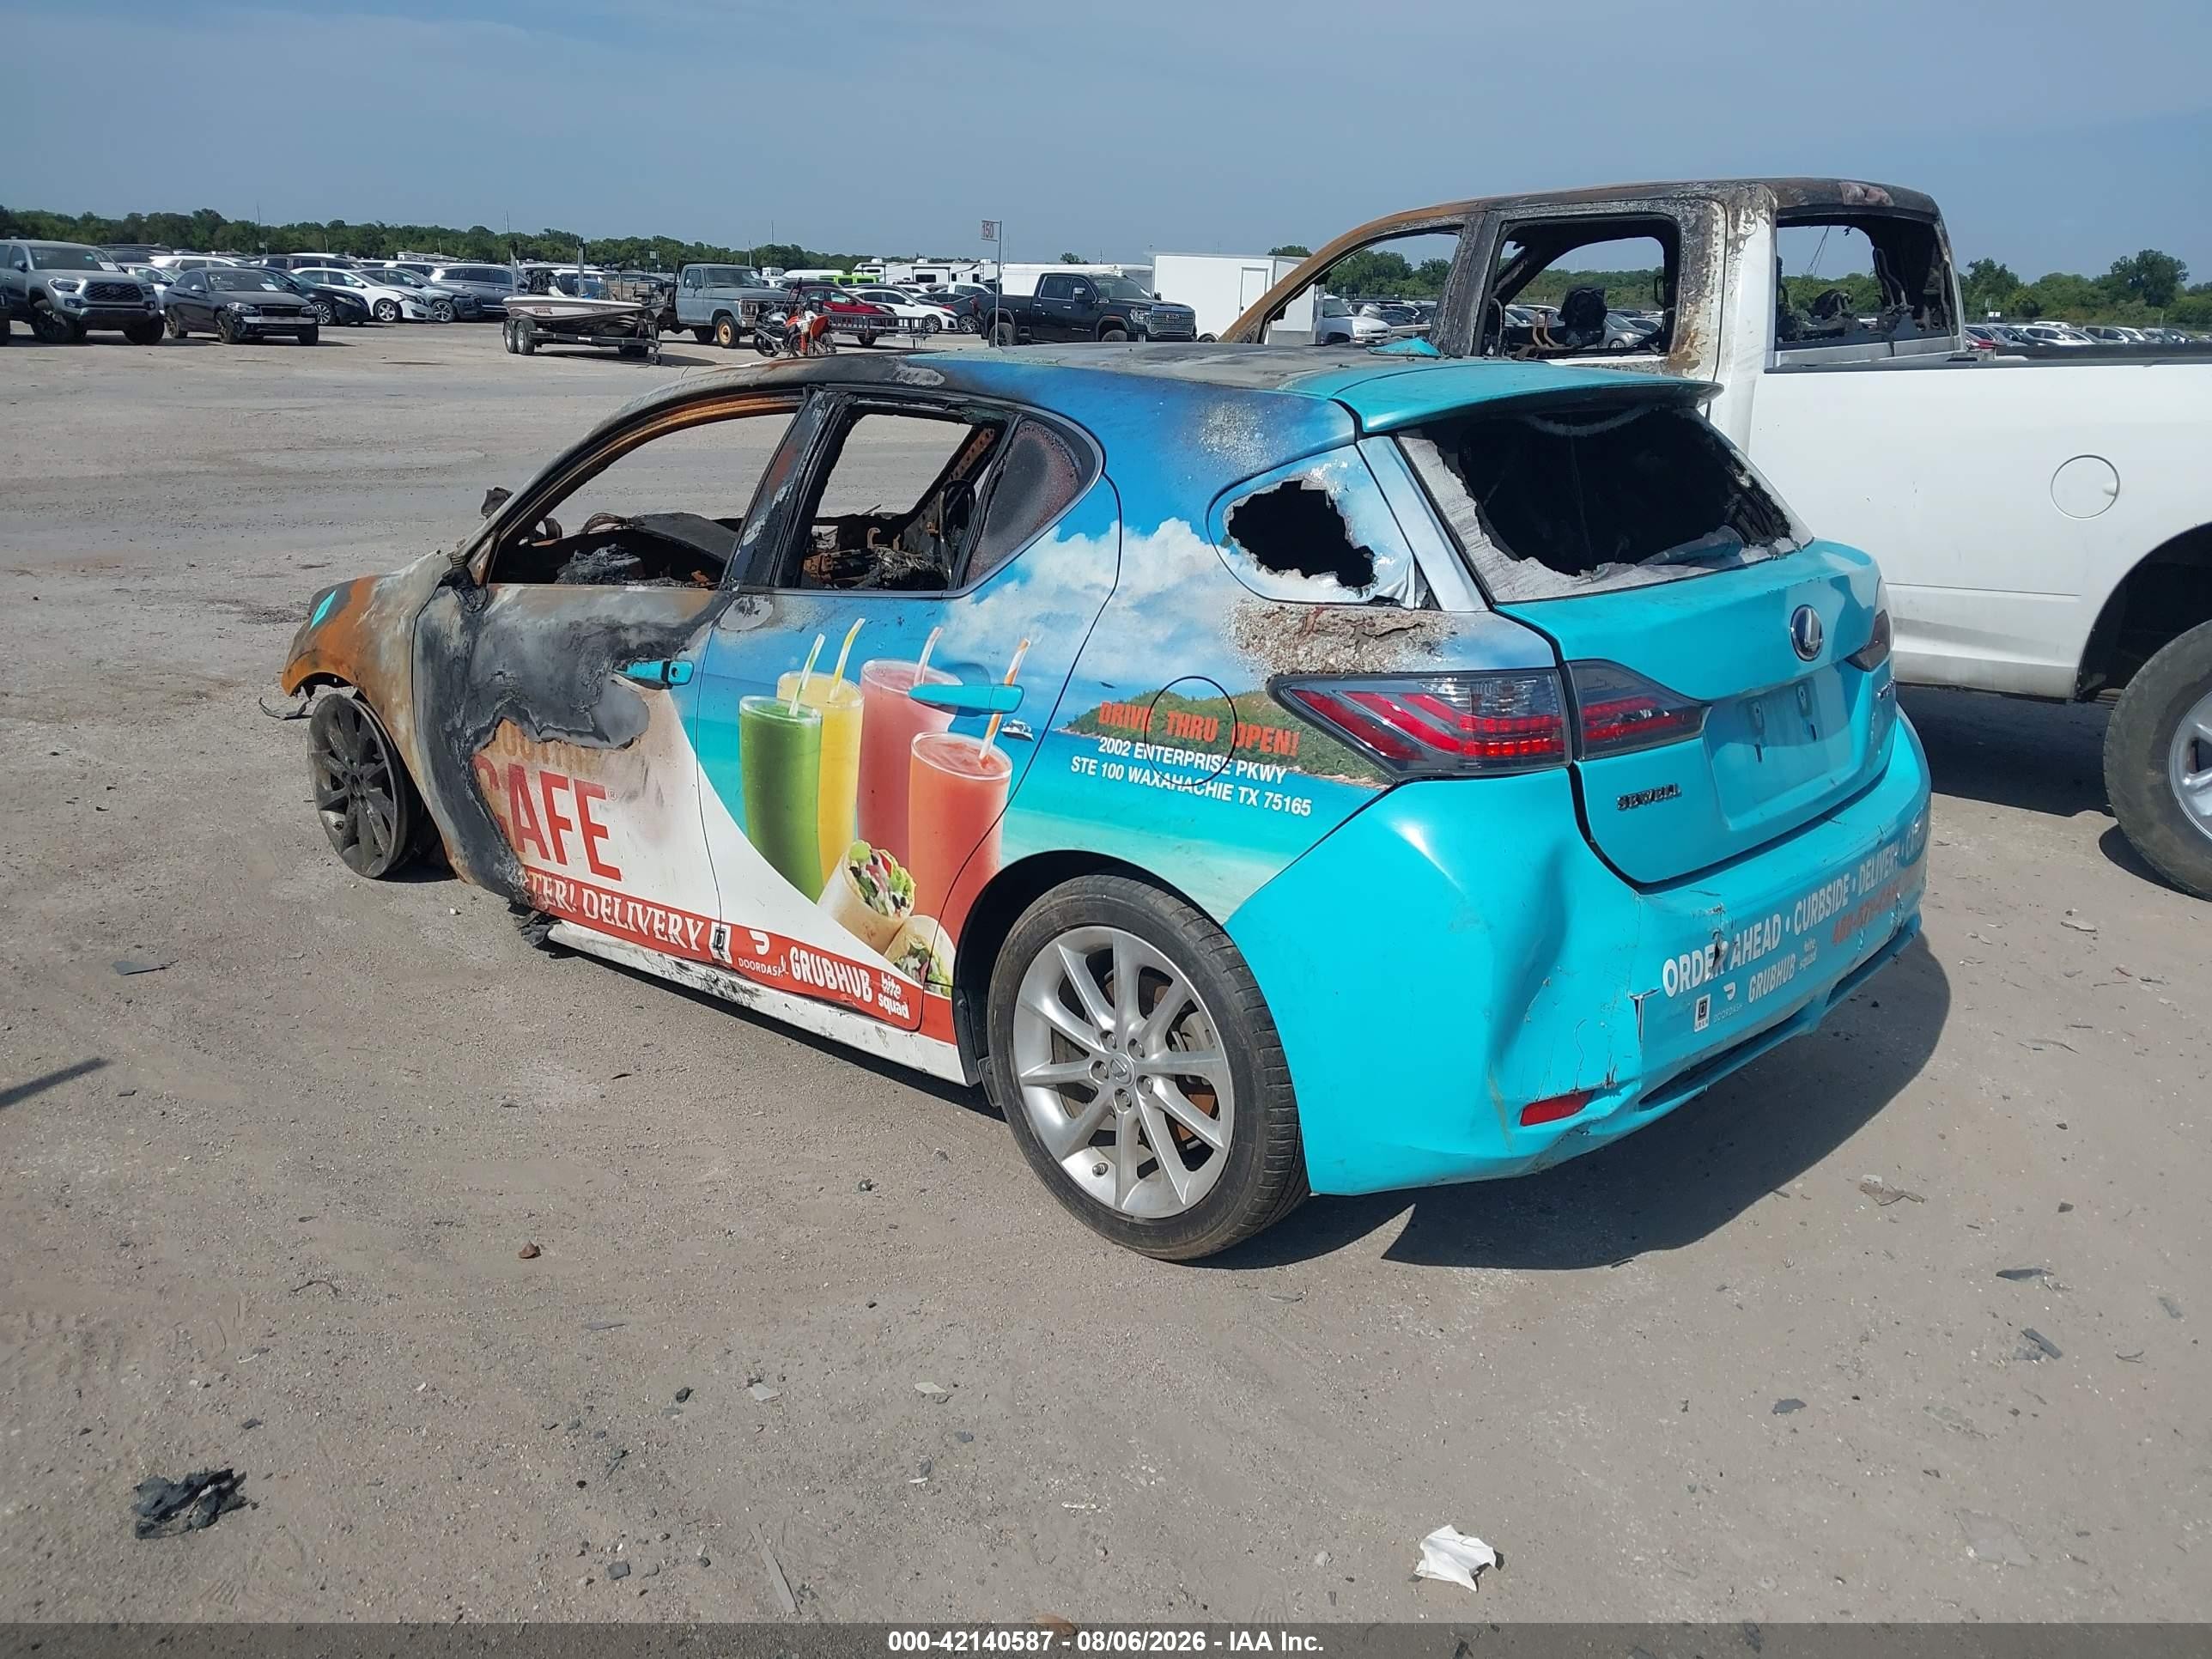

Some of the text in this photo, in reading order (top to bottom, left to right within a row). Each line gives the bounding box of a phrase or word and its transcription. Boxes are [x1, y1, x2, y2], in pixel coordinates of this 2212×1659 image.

[982, 222, 994, 238] 150
[1098, 702, 1300, 757] DRIVE THRU OPEN!
[1098, 737, 1287, 785] 2002 ENTERPRISE PKWY
[1071, 756, 1312, 817] STE 100 WAXAHACHIE TX 75165
[1617, 783, 1683, 811] SEWELL
[582, 890, 703, 951] DELIVERY
[1662, 940, 1729, 998] ORDER
[1729, 914, 1782, 971] AHEAD
[1794, 872, 1850, 936] CURBSIDE
[789, 946, 873, 1003] GRUBHUB
[880, 972, 902, 1000] bite
[1748, 953, 1796, 1003] GRUBHUB
[878, 994, 910, 1020] squad
